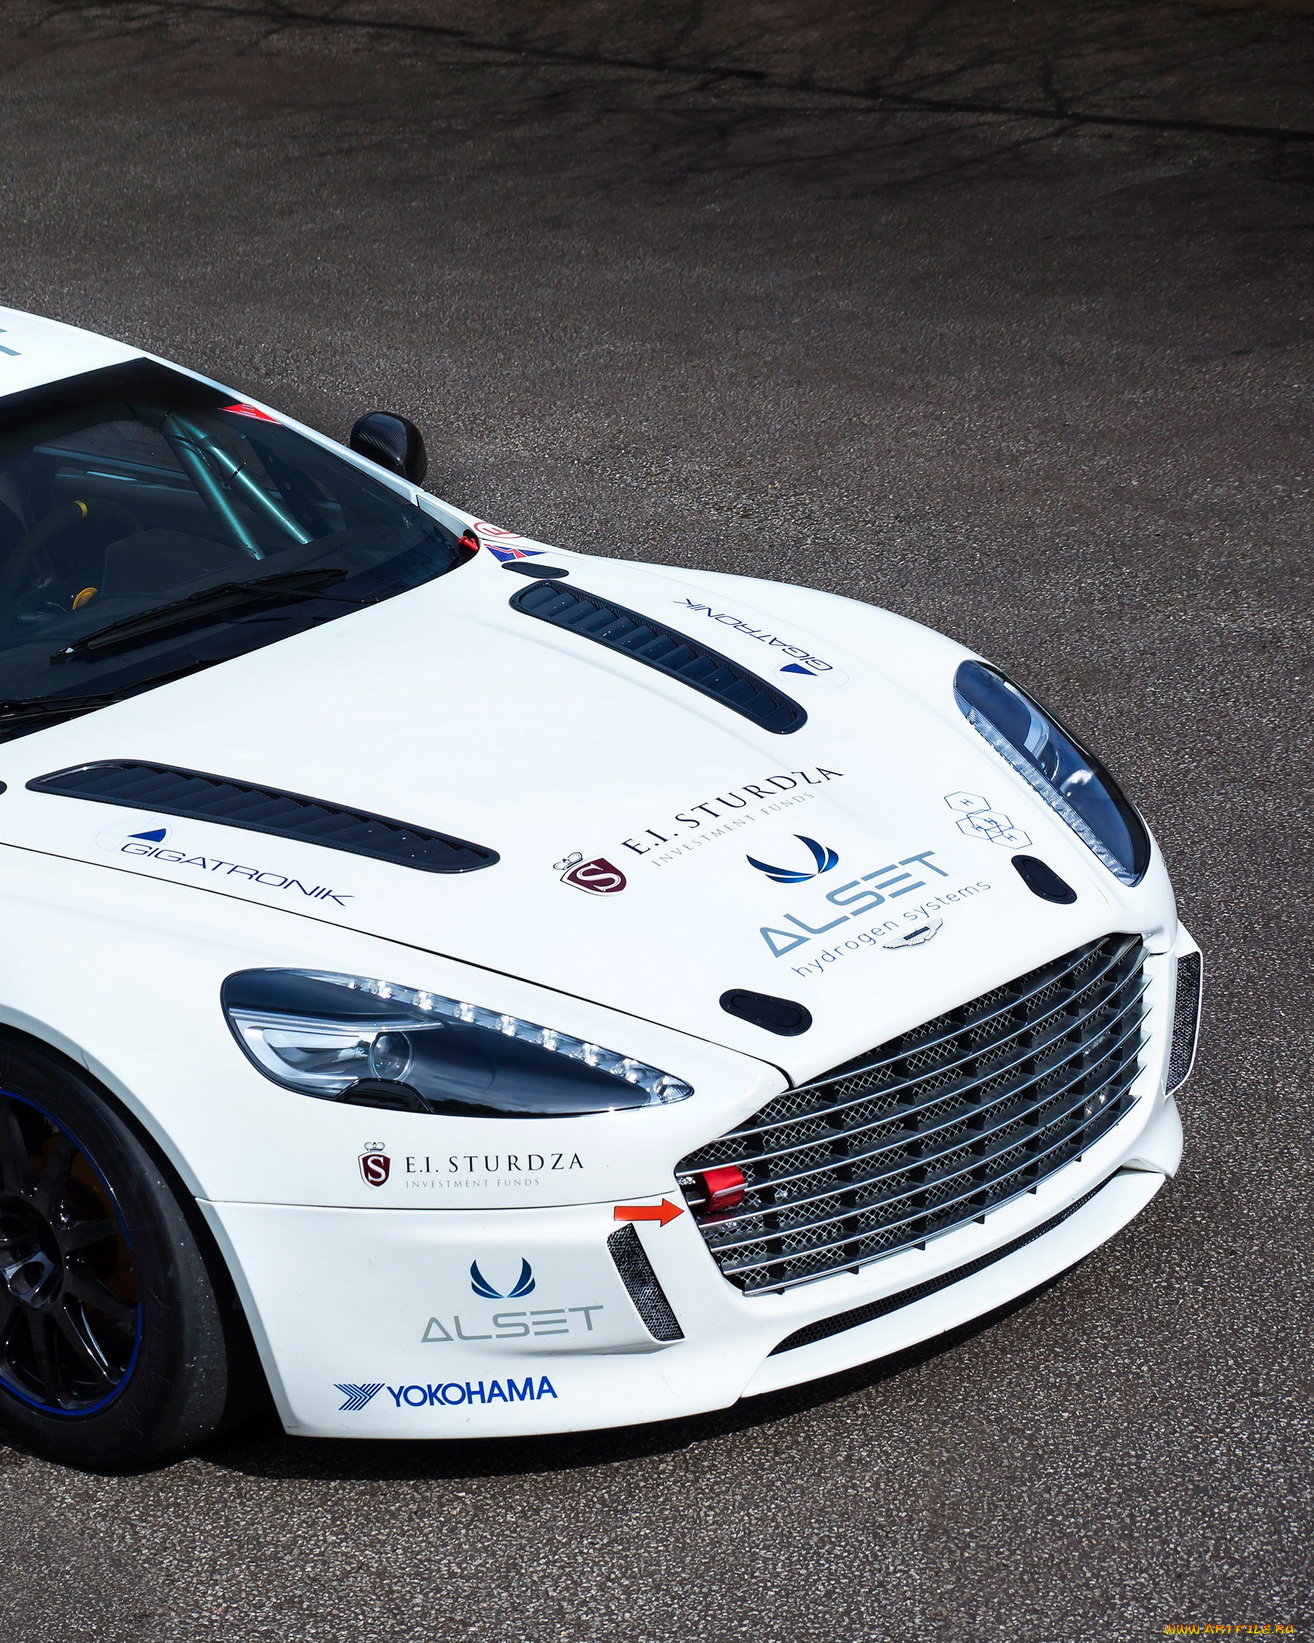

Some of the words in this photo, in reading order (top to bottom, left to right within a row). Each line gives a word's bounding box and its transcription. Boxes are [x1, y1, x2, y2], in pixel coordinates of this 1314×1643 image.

[672, 598, 834, 671] GIGATRONIK
[619, 828, 679, 856] E.I.
[674, 766, 846, 829] STURDZA
[651, 813, 756, 867] INVESTMENT
[760, 791, 815, 815] FUNDS
[120, 842, 355, 907] GIGATRONIK
[759, 850, 949, 959] ALSET
[790, 917, 900, 978] hydrogen
[902, 880, 992, 922] systems
[405, 1156, 439, 1174] E.I.
[448, 1152, 585, 1174] STURDZA
[405, 1179, 489, 1189] INVESTMENT
[496, 1178, 541, 1188] FUNDS
[420, 1304, 604, 1344] ALSET
[386, 1374, 558, 1408] YOKOHAMA
